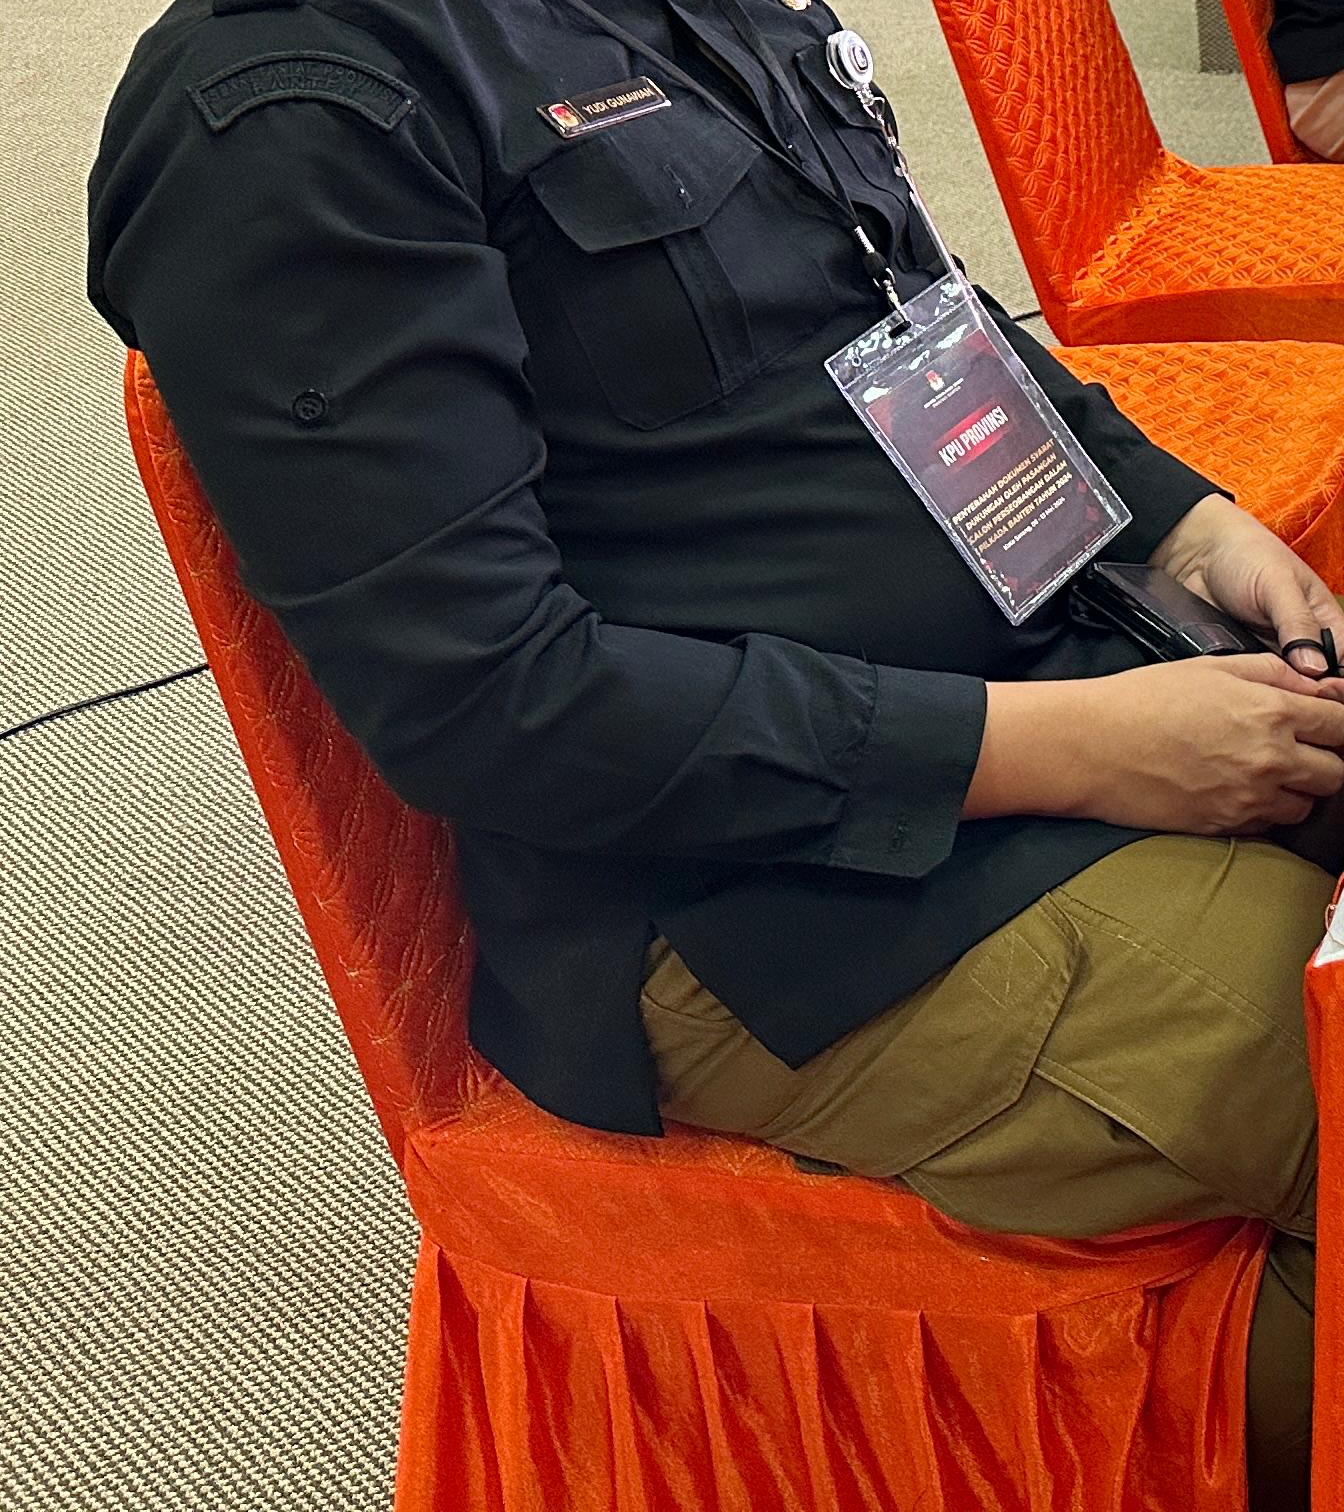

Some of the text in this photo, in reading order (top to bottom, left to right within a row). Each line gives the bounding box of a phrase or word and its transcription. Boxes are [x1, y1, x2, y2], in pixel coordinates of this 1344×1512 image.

[582, 101, 609, 115] YUDI
[938, 405, 1009, 466] KPU PROVINSI
[1021, 452, 1057, 486] PASANGAN
